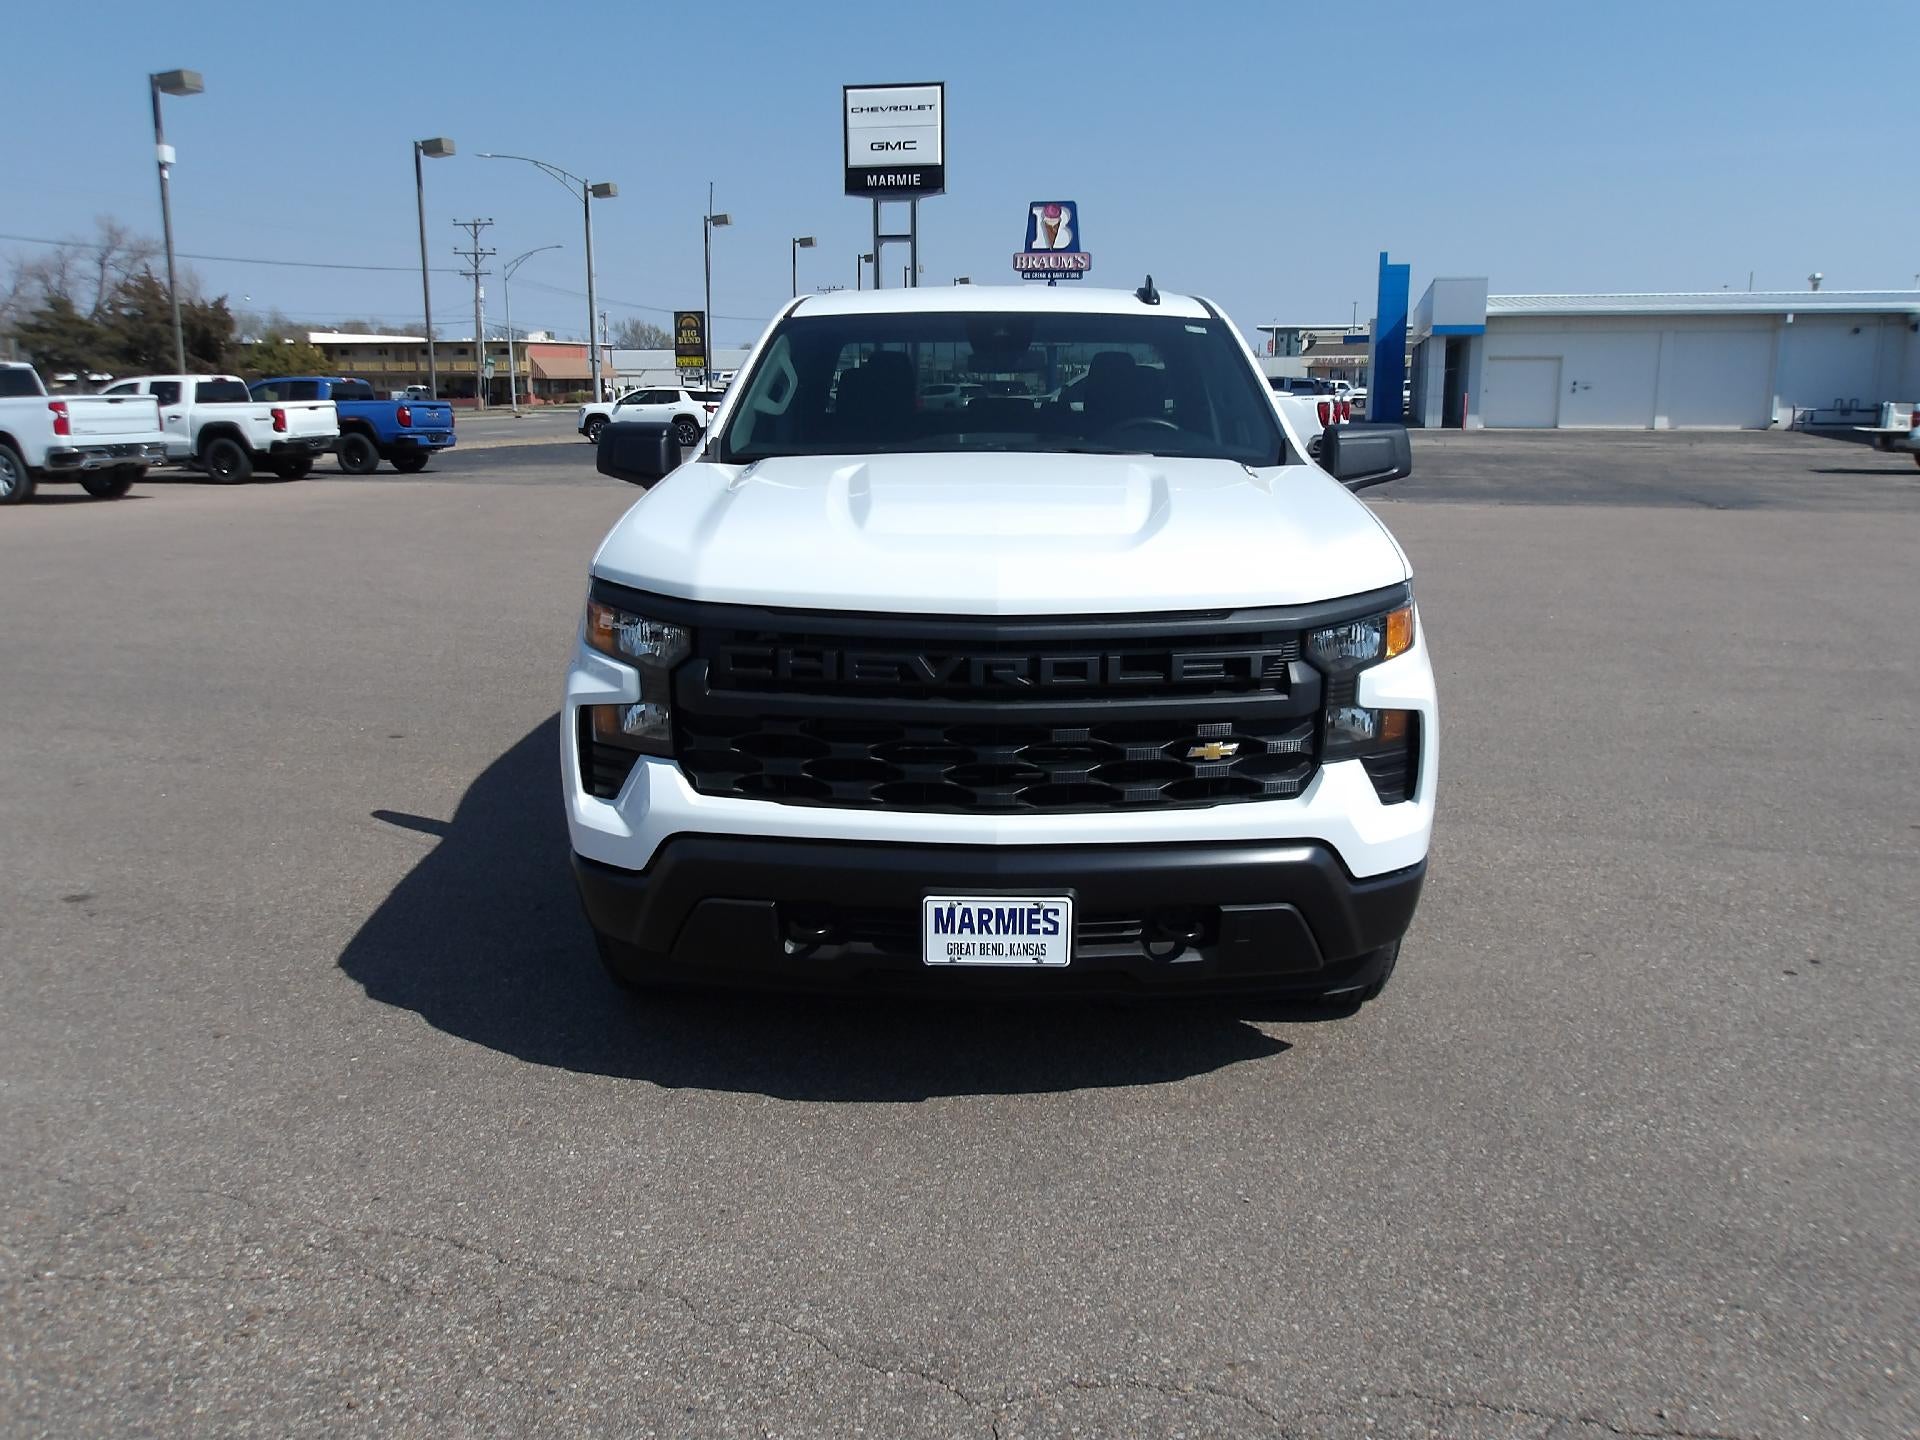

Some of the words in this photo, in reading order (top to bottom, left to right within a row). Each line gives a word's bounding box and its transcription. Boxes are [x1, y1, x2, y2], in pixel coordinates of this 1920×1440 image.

[851, 104, 935, 113] CHEVROLET
[870, 140, 917, 151] GMC
[866, 174, 921, 187] MARMIE
[1016, 255, 1086, 269] BRAUM'S
[682, 329, 697, 337] BIG
[719, 645, 1283, 690] CHEVROLET
[934, 907, 1060, 935] MARMIES
[946, 942, 976, 956] GREAT
